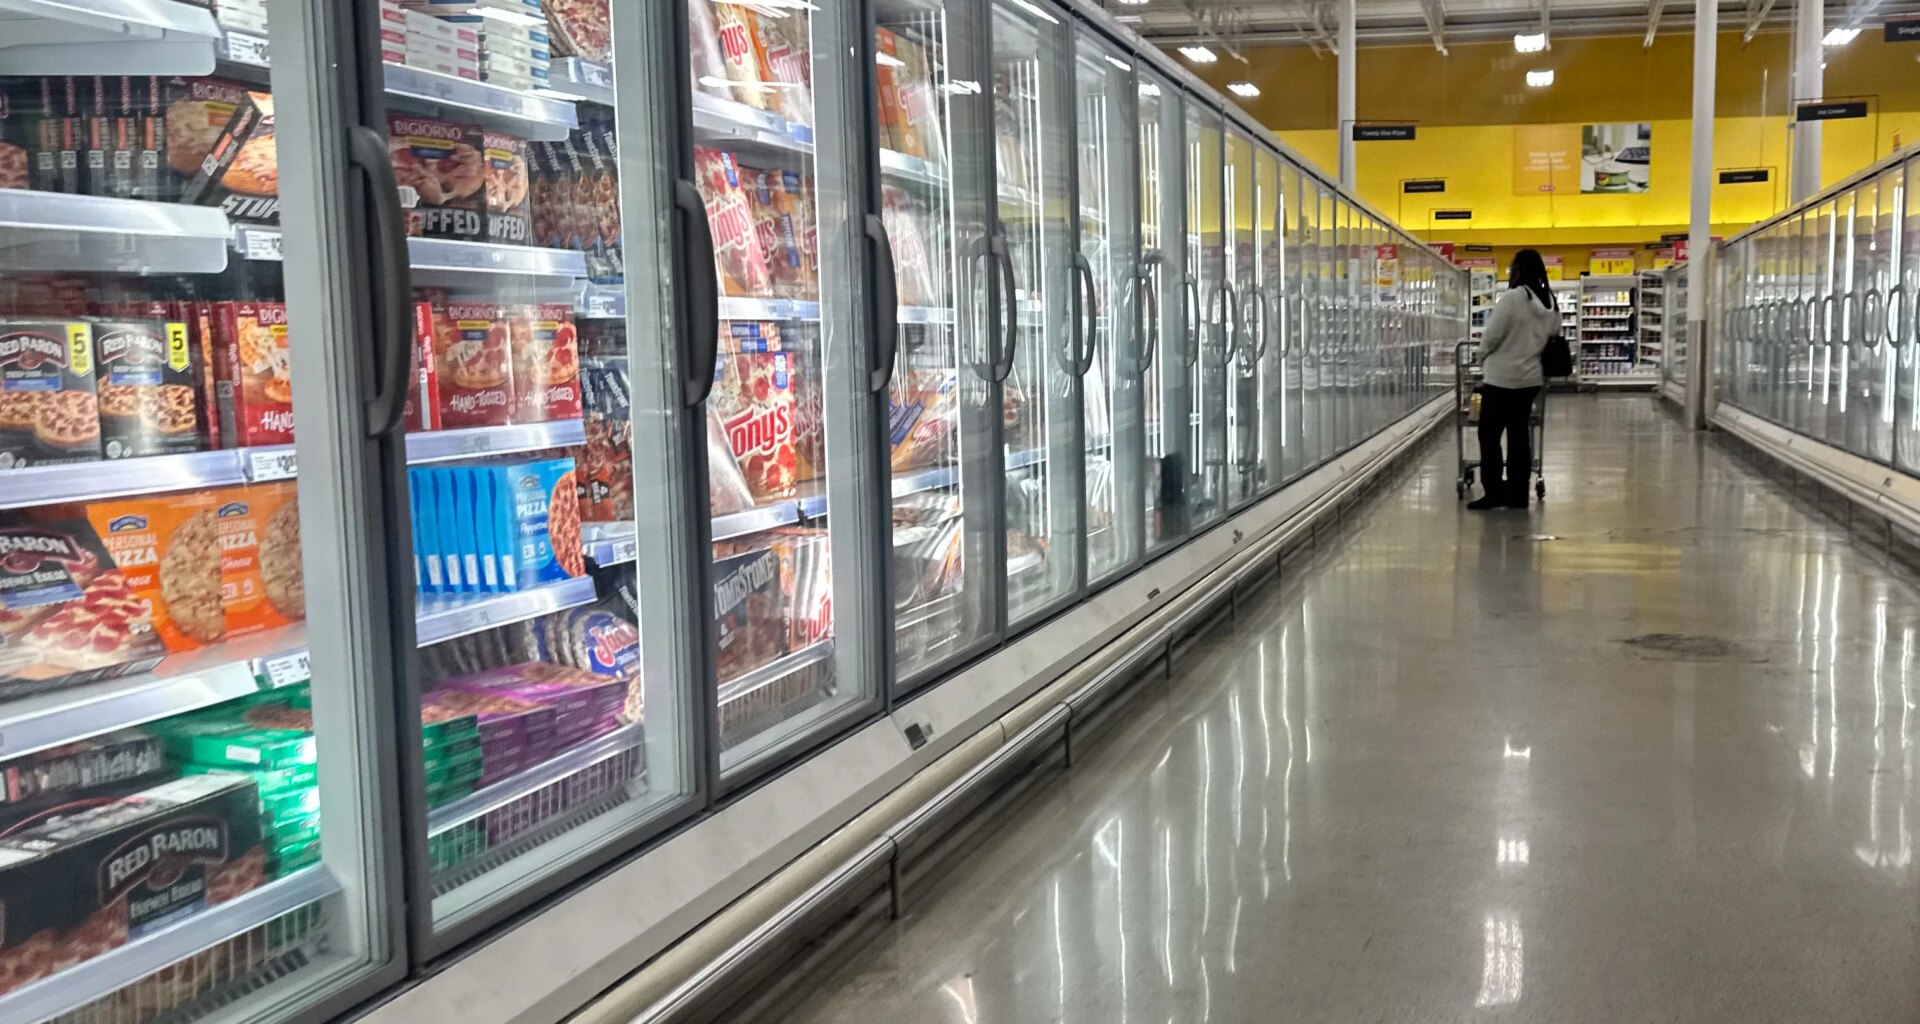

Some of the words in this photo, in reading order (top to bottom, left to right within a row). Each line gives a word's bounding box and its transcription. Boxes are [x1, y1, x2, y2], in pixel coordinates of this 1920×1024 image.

[73, 333, 86, 354] 5
[172, 331, 183, 350] 5
[725, 403, 788, 457] Tony's
[516, 500, 548, 518] PIZZA
[108, 844, 150, 891] RED
[151, 826, 219, 861] BARON
